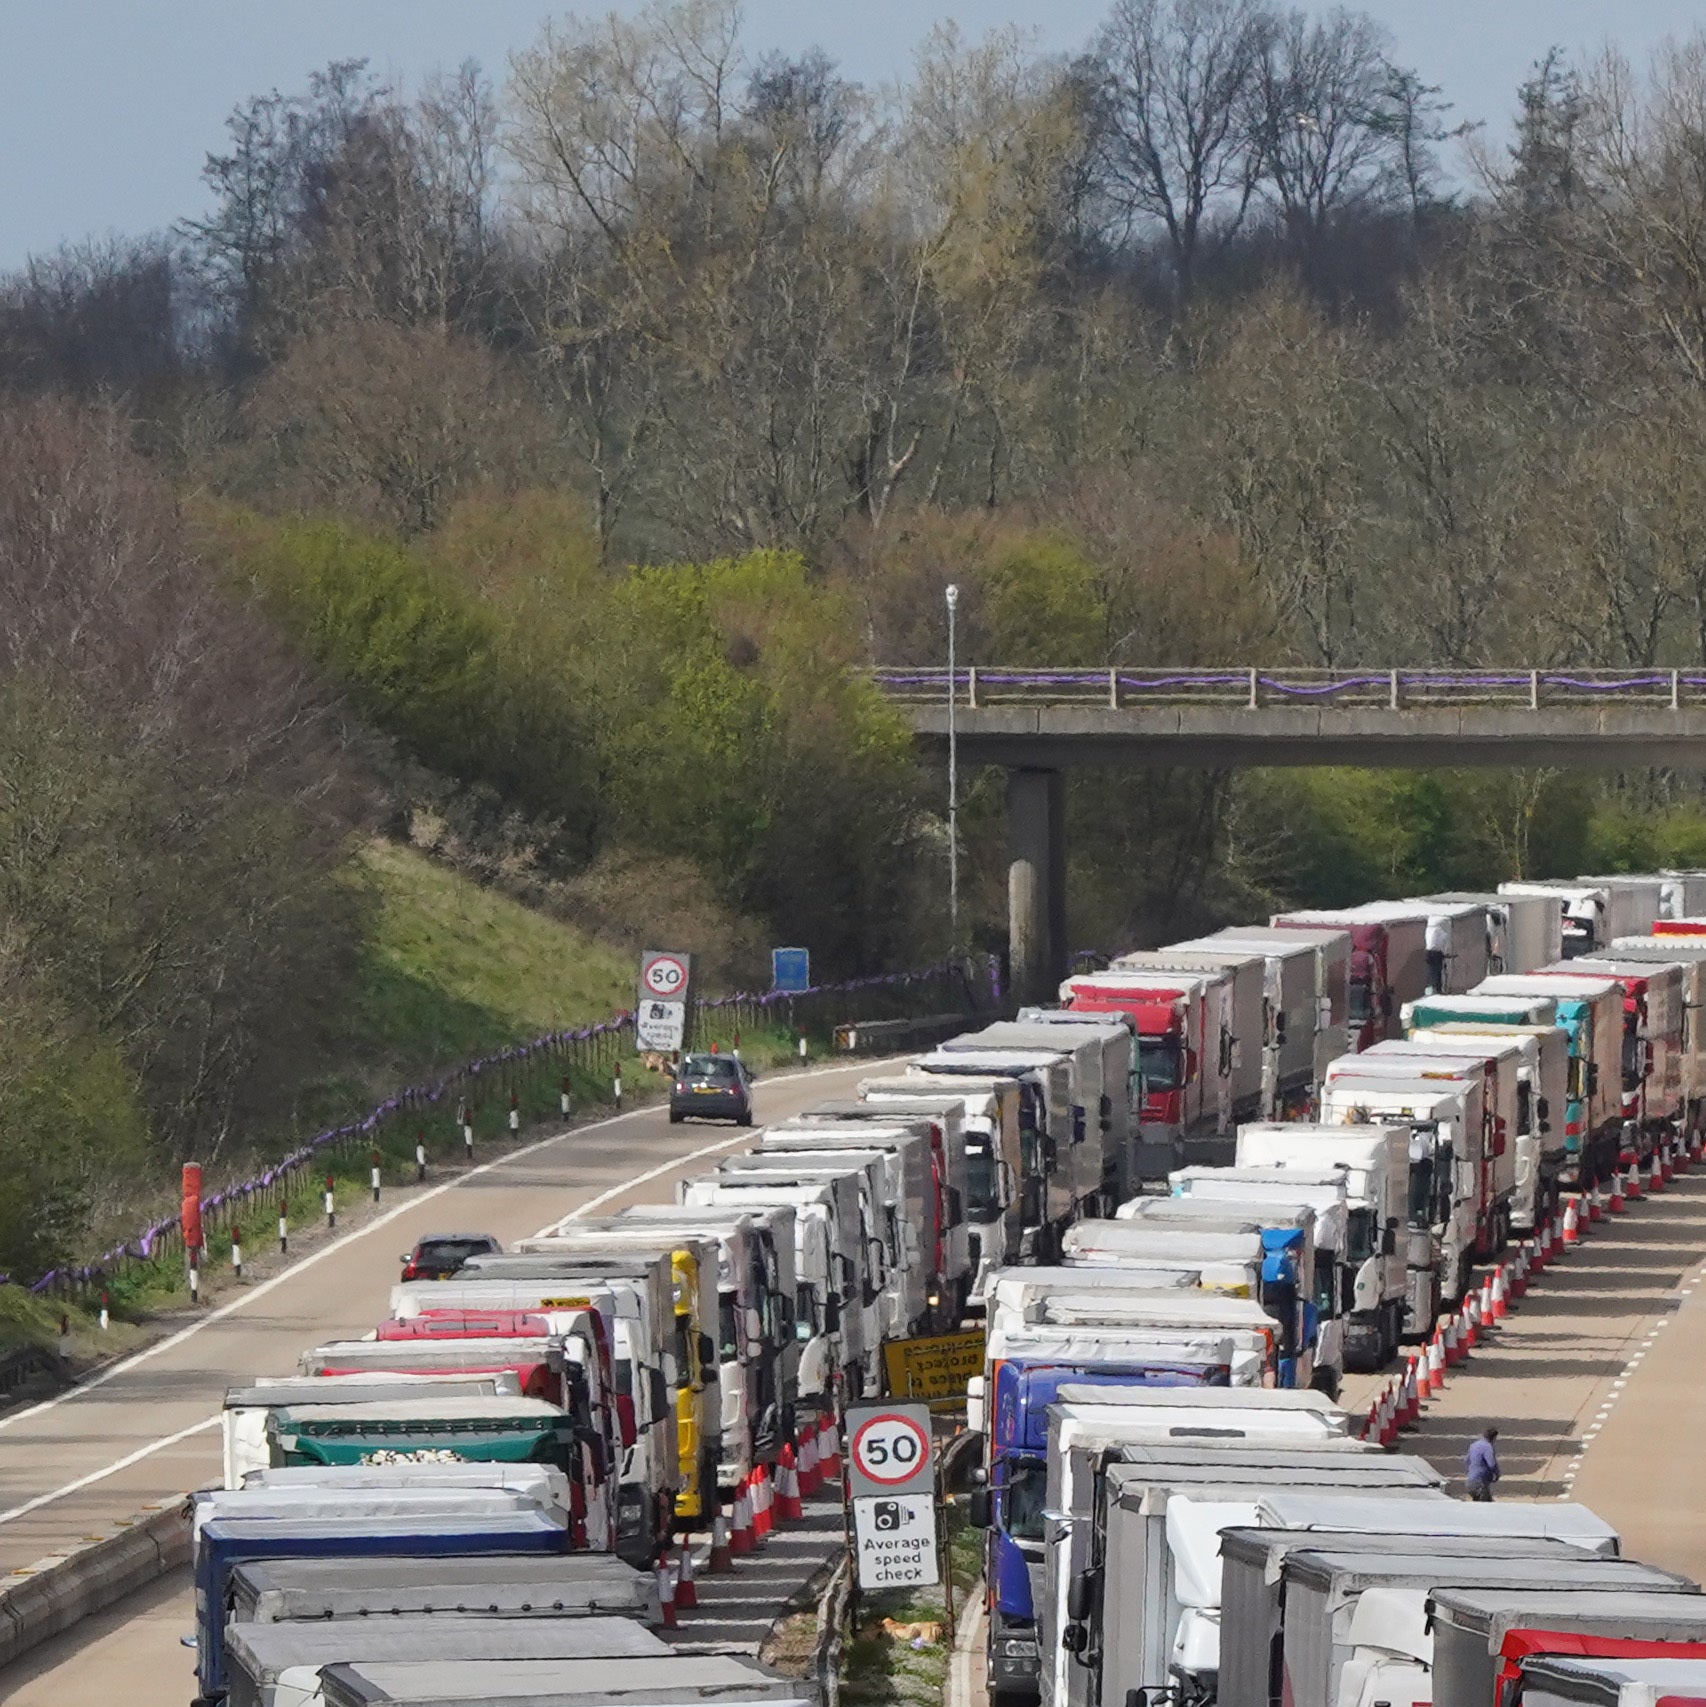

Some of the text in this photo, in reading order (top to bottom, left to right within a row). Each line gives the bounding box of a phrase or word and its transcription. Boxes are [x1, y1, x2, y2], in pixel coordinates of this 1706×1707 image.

[652, 968, 680, 985] 50
[866, 1435, 917, 1465] 50
[864, 1537, 931, 1552] Average
[874, 1553, 922, 1567] speed
[875, 1567, 923, 1582] check
